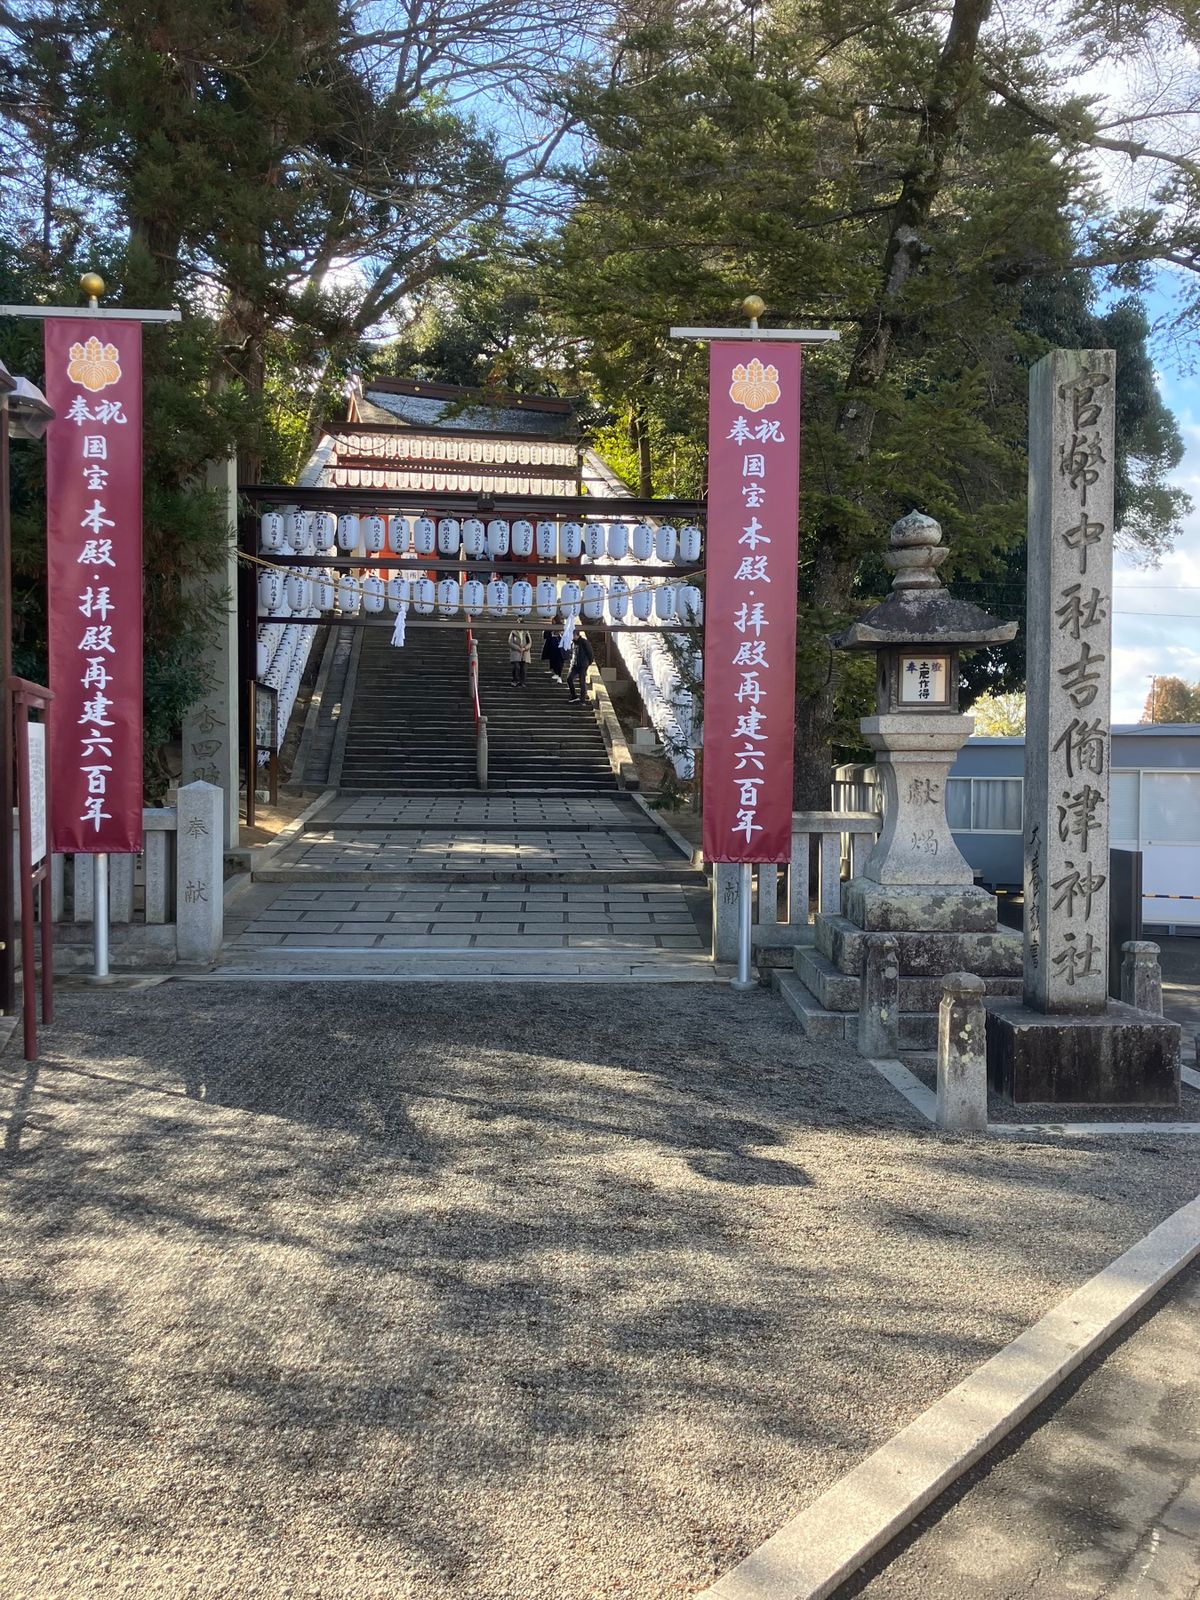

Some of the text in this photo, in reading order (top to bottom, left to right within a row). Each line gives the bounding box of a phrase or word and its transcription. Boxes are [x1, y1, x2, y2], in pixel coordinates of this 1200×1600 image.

[64, 395, 128, 426] 奉祝
[726, 415, 786, 446] 奉祝
[918, 661, 930, 700] 土肥作得
